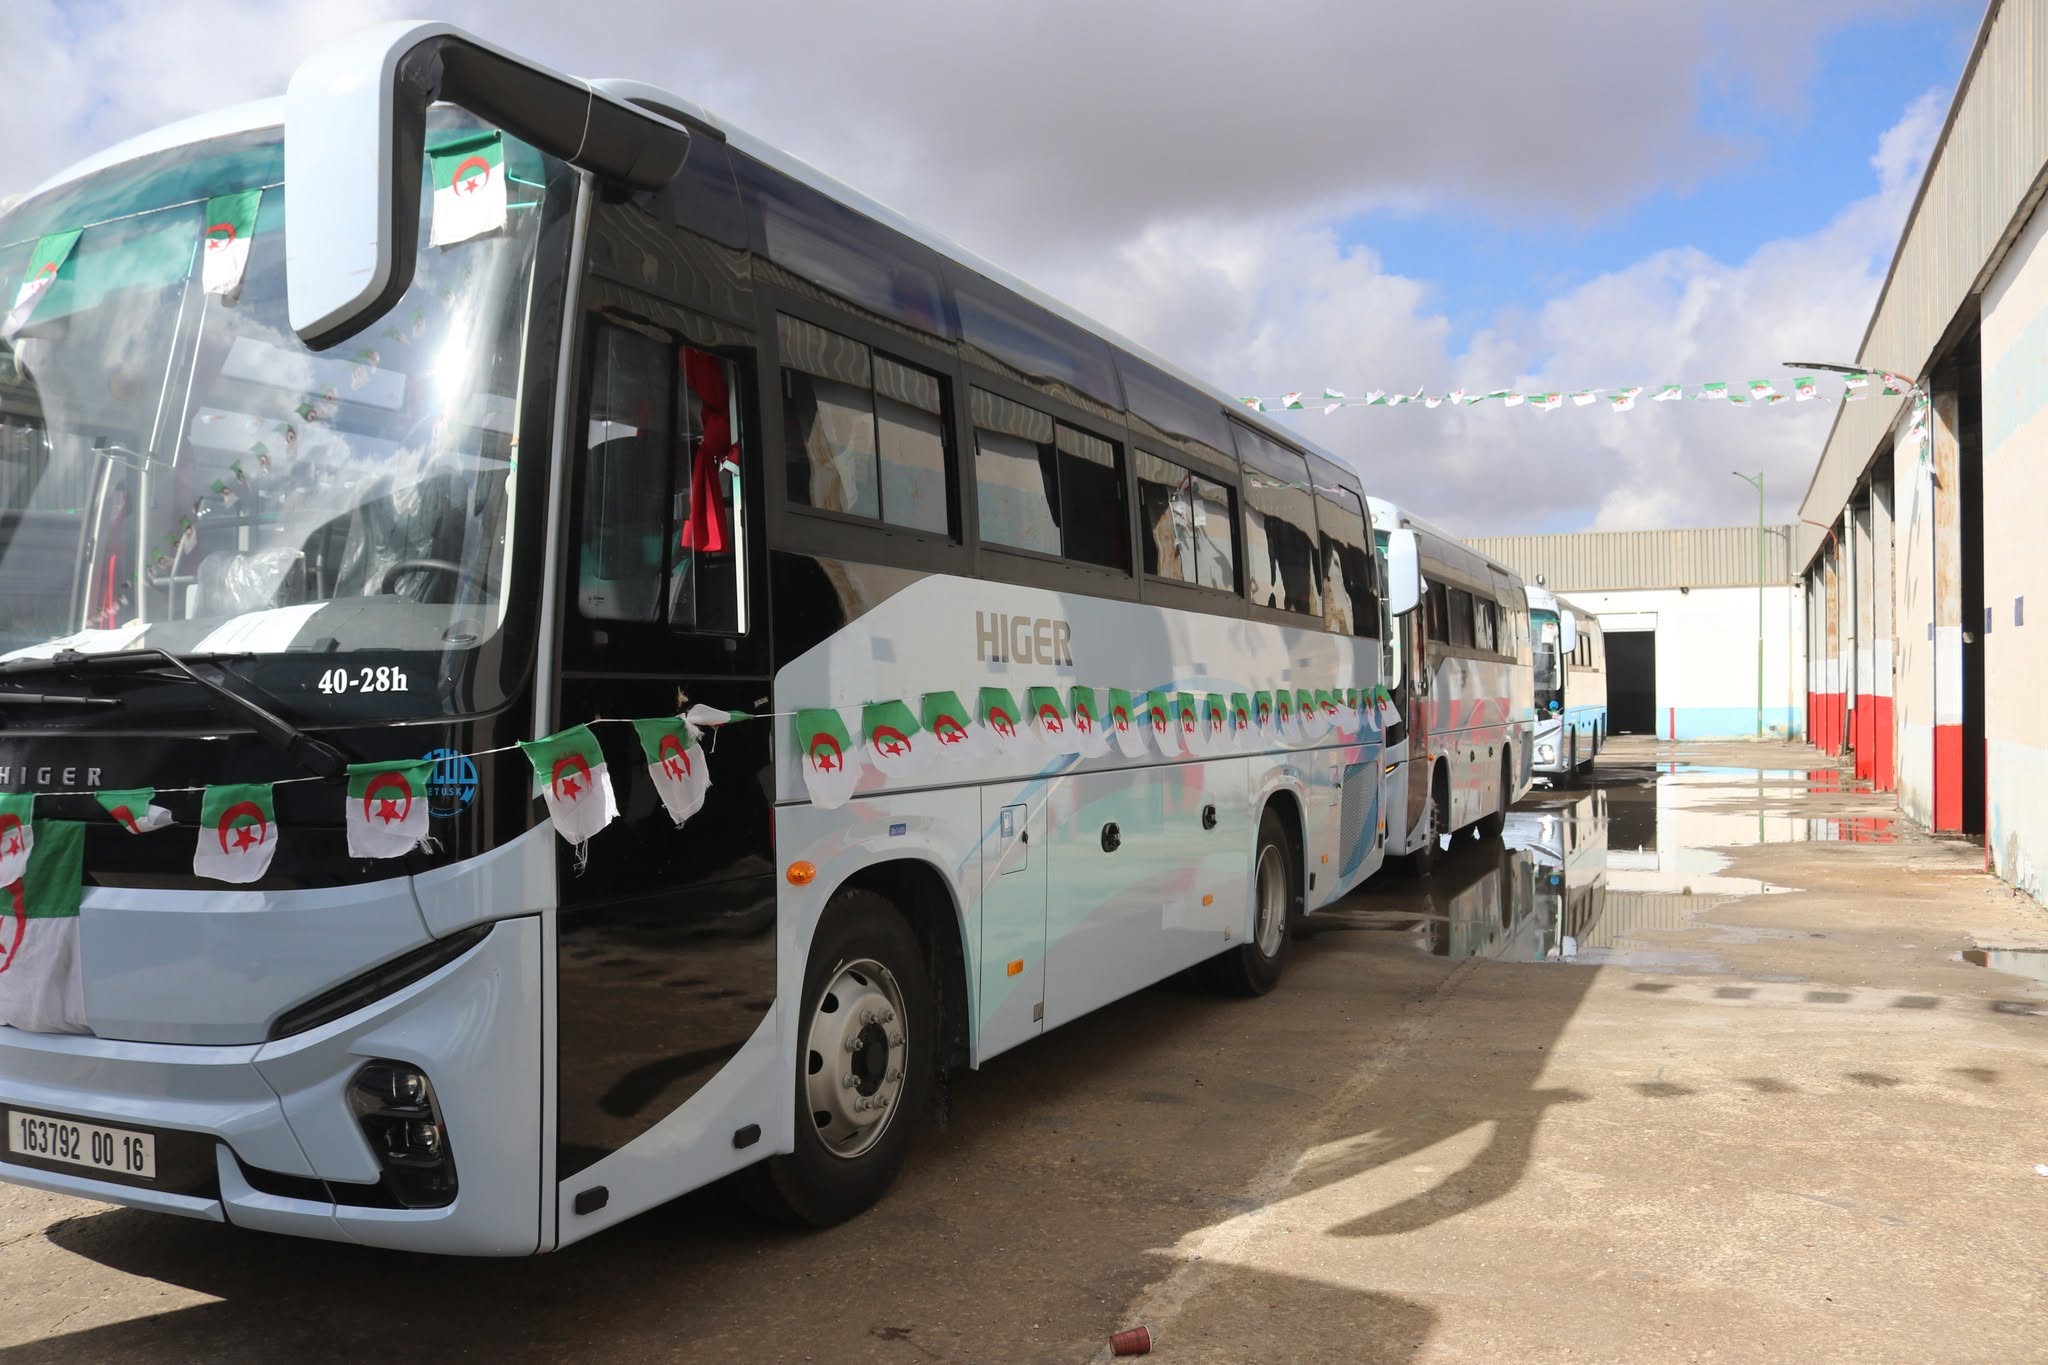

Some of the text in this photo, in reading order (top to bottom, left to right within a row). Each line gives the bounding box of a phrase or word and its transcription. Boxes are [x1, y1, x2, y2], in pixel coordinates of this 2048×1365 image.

[975, 610, 1073, 666] HIGER
[317, 666, 408, 694] 40-28h
[0, 766, 102, 786] HIGER
[21, 1118, 144, 1171] 163792 00 16
